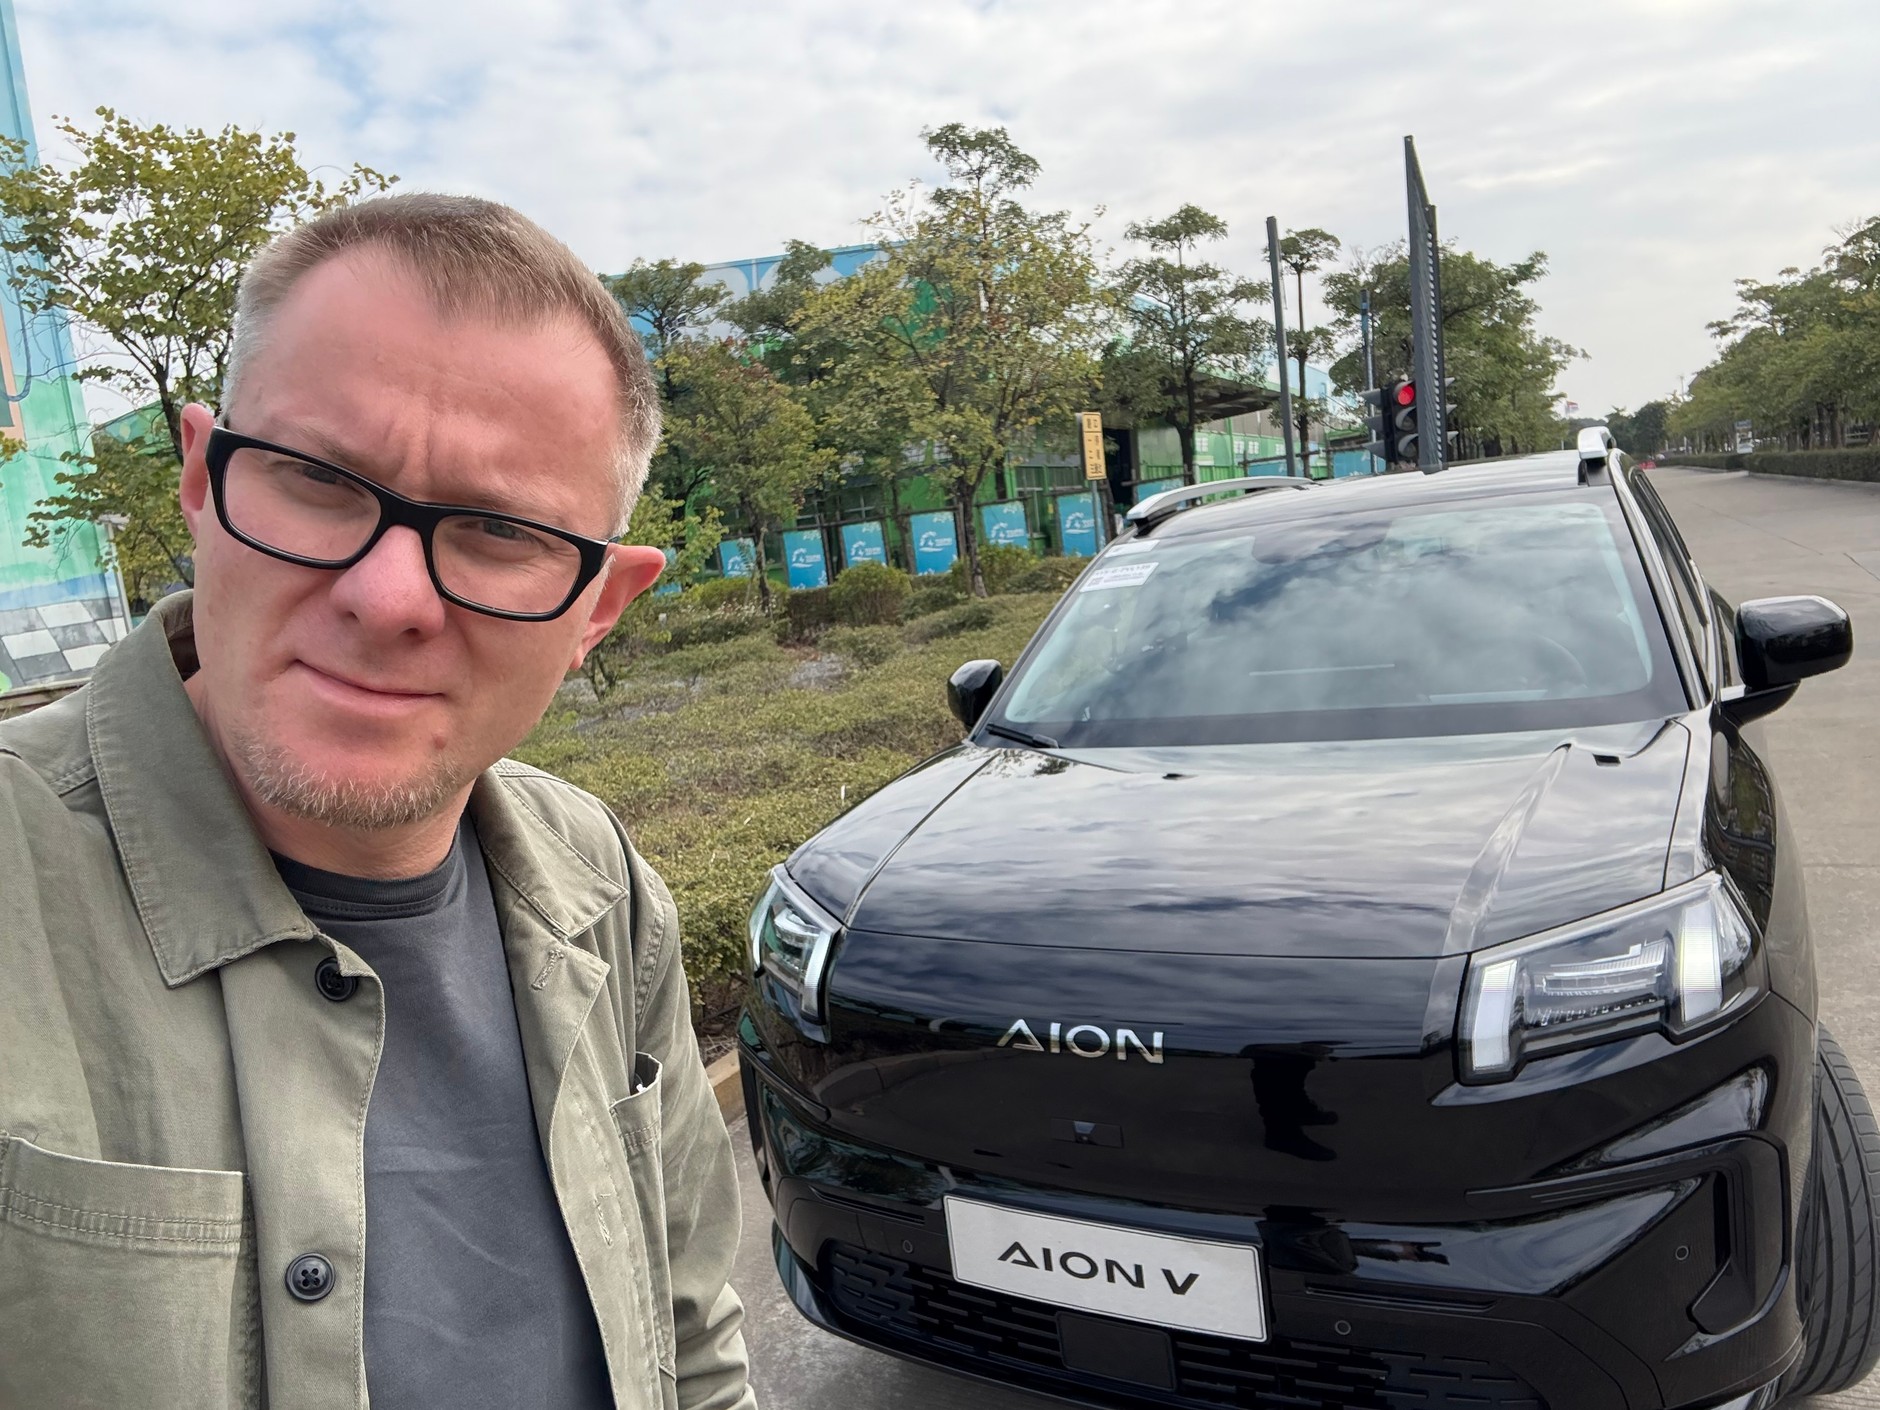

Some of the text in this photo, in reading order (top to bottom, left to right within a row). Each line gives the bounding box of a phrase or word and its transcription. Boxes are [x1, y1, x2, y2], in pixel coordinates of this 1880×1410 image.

[998, 1018, 1164, 1064] AION
[998, 1241, 1199, 1295] AION V
